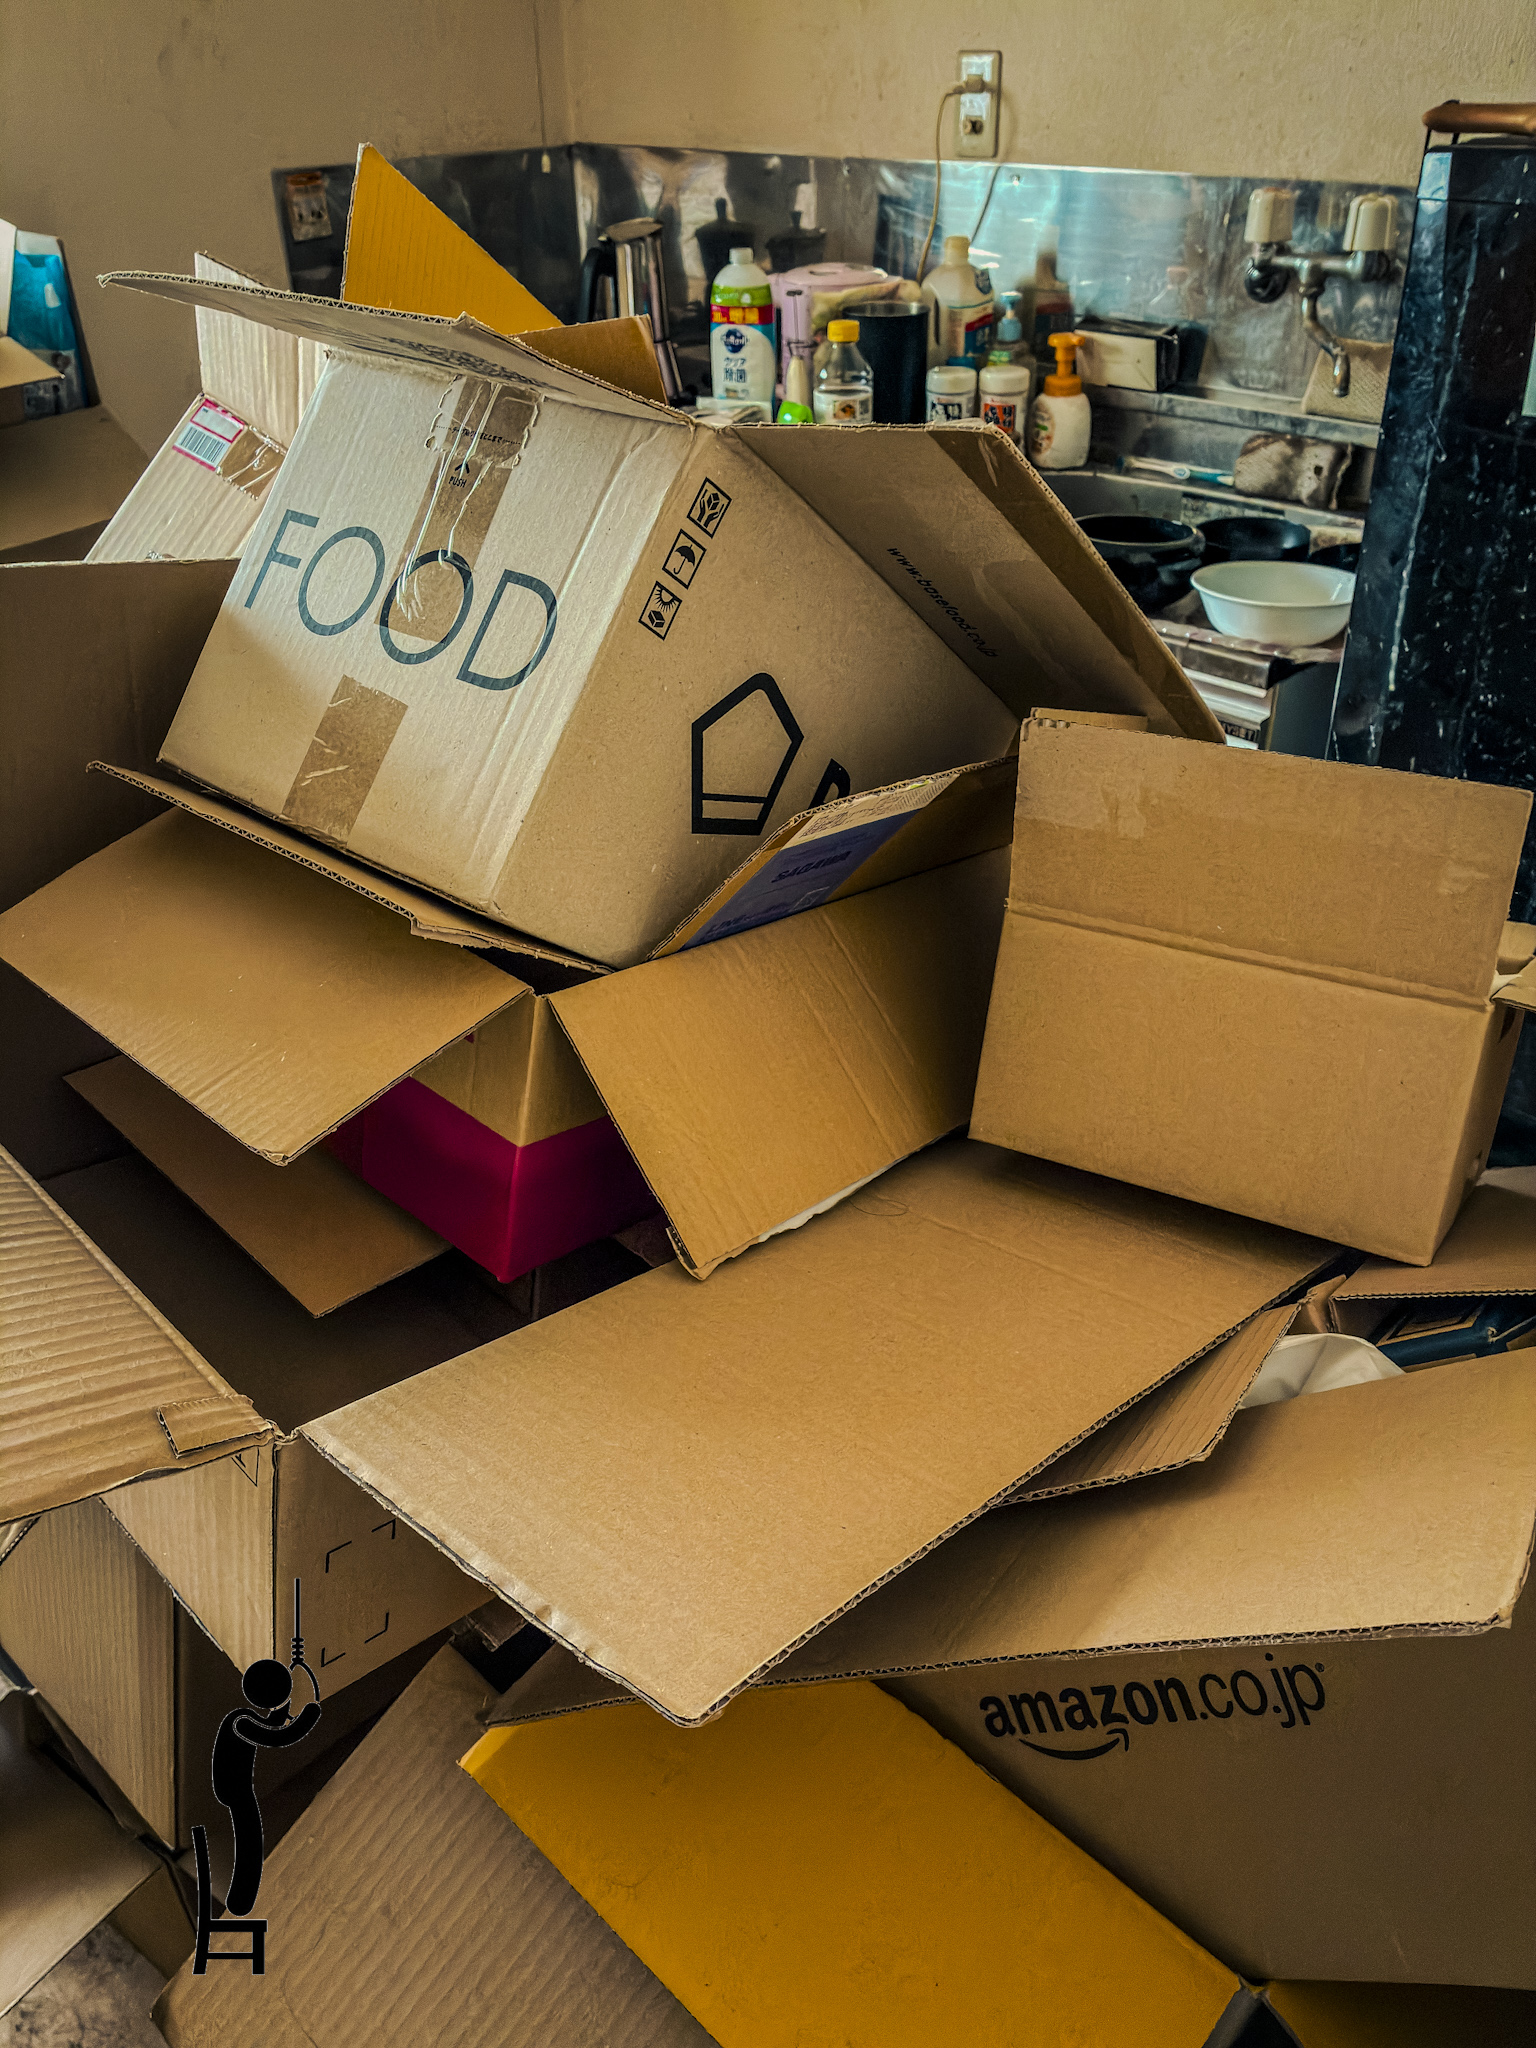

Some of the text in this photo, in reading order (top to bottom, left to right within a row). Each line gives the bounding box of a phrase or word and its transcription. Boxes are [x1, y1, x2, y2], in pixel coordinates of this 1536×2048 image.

[449, 475, 467, 488] PUSH
[244, 509, 557, 691] FOOD
[979, 1652, 1326, 1738] amazon.co.jp
